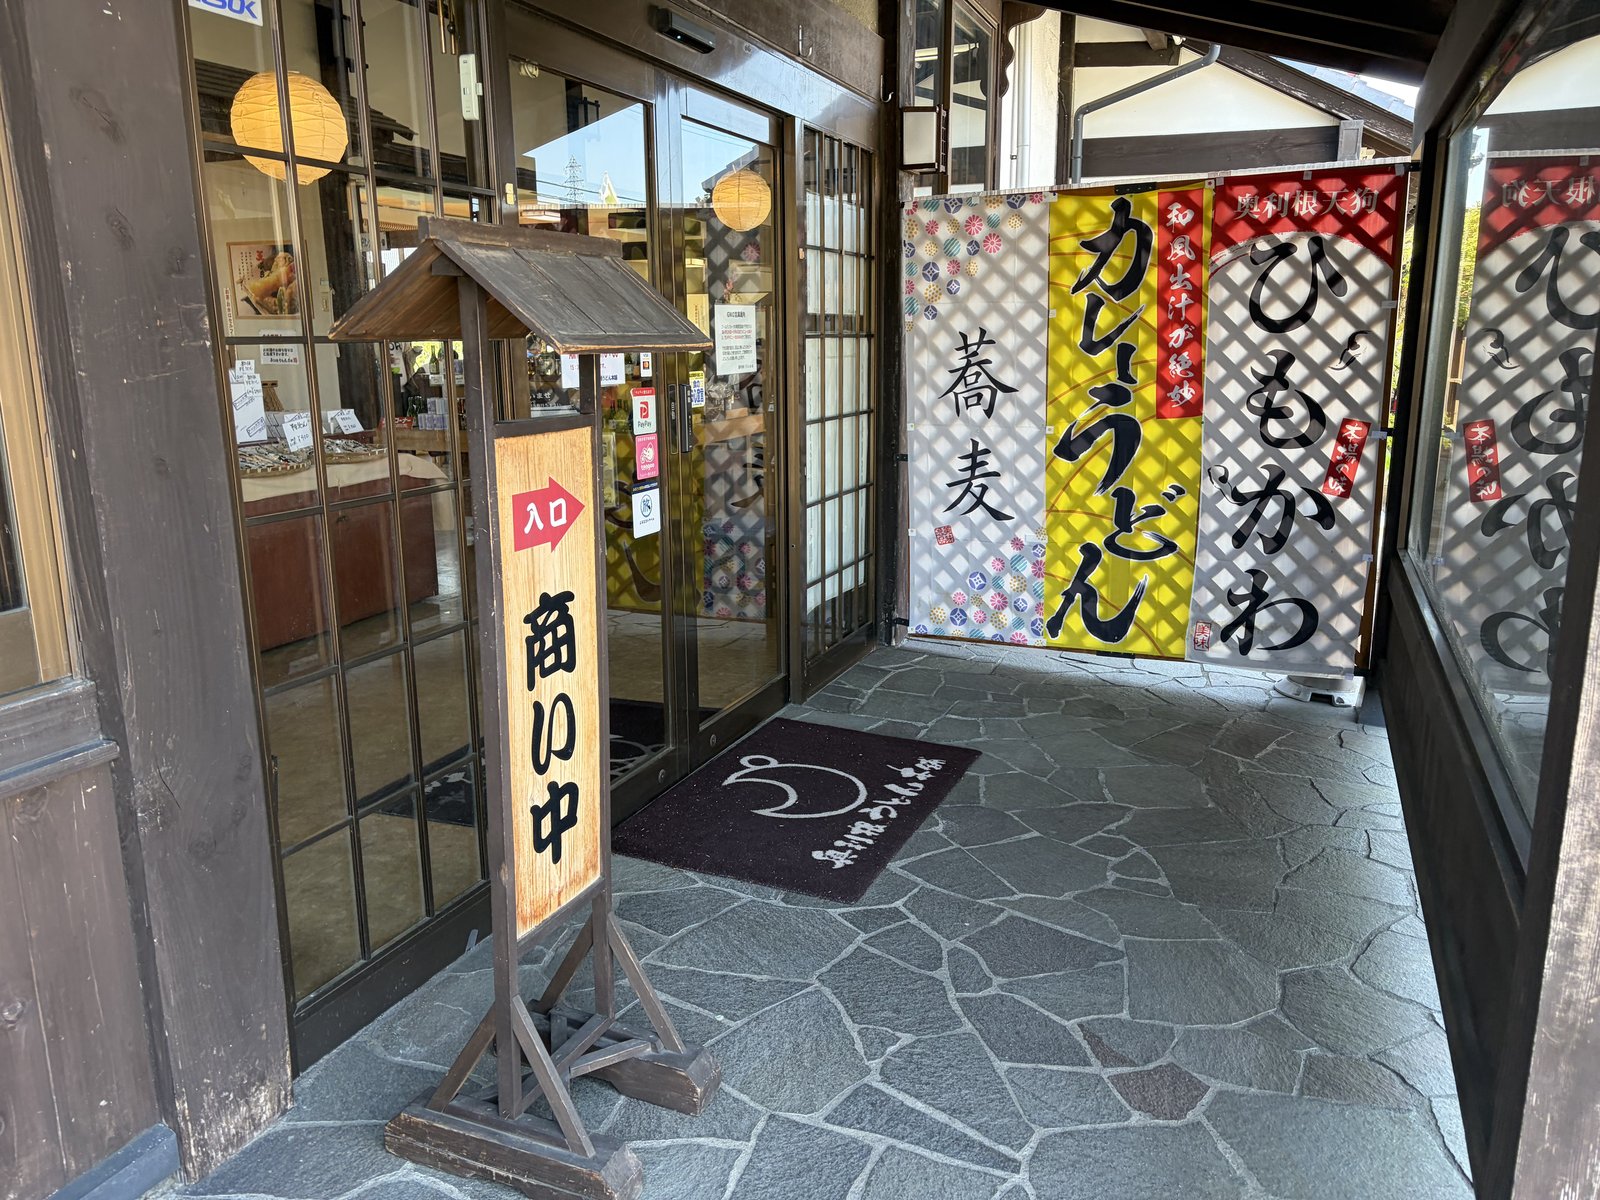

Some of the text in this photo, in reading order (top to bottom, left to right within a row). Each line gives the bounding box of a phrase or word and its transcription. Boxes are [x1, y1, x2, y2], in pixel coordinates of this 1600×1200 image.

[1234, 187, 1379, 220] 奥利根天狗
[1166, 202, 1196, 408] 和風出汁が絶妙
[524, 497, 567, 535] 入口
[637, 420, 652, 429] PayPay
[938, 326, 1019, 522] 蕎麦
[1045, 197, 1187, 643] カレーうどん
[1221, 235, 1348, 656] ひもかわ
[1328, 424, 1364, 494] 本場の味
[524, 591, 579, 864] 商い中
